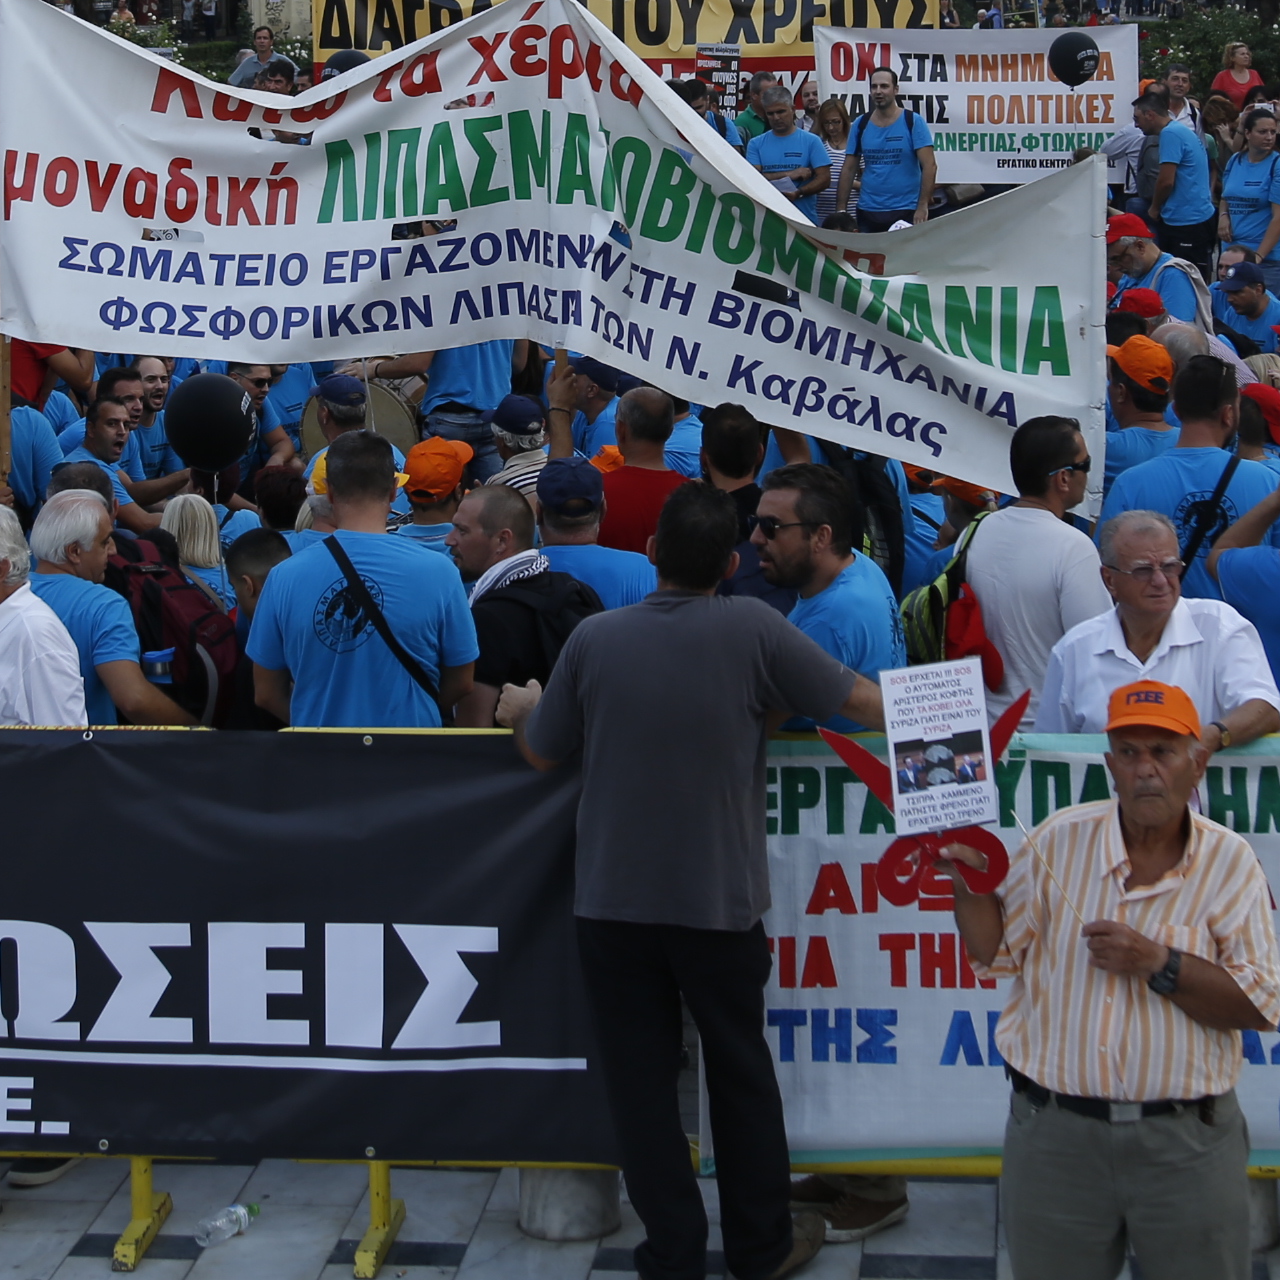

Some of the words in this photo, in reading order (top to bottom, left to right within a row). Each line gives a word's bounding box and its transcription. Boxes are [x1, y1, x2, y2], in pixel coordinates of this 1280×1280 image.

[830, 41, 891, 82] ΟΧΙ
[898, 53, 948, 82] ΣΤΑ
[955, 51, 1115, 82] ΜΝΗΜΑ
[966, 94, 1115, 125] ΠΟΛΙΤΙΚΕΣ
[4, 149, 299, 227] μοναδική
[58, 236, 309, 287] ΣΩΜΑΤΕΙΟ
[708, 291, 1019, 428] ΒΙΟΜΗΧΑΝΙΑ
[99, 294, 433, 341] ΦΩΣΦΟΡΙΚΩΝ
[666, 335, 709, 381] Ν.
[727, 353, 949, 458] Καβάλας
[890, 676, 908, 686] SOS
[909, 671, 943, 684] ΕΡΧΕΤΑΙ
[954, 666, 972, 676] SOS
[913, 679, 962, 693] ΑΥΤΟΜΑΤΟΣ
[893, 694, 938, 707] ΑΡΙΣΤΕΡΟΣ
[940, 688, 975, 700] ΚΟΦΤΗΣ
[1124, 688, 1166, 707] ΓΣΕΕ
[897, 708, 915, 717] ΠΟΥ
[917, 705, 928, 714] ΤΑ
[929, 702, 954, 713] ΚΟΒΕΙ
[890, 719, 920, 730] ΣΥΡΙΖΑ
[942, 712, 964, 722] ΕΙΝΑΙ
[923, 724, 953, 736] ΣΥΡΙΖΑ
[941, 786, 984, 800] ΚΑΜΜΕΝΟ
[939, 799, 970, 811] ΦΡΕΝΟ
[767, 1009, 898, 1065] ΤΗΣ
